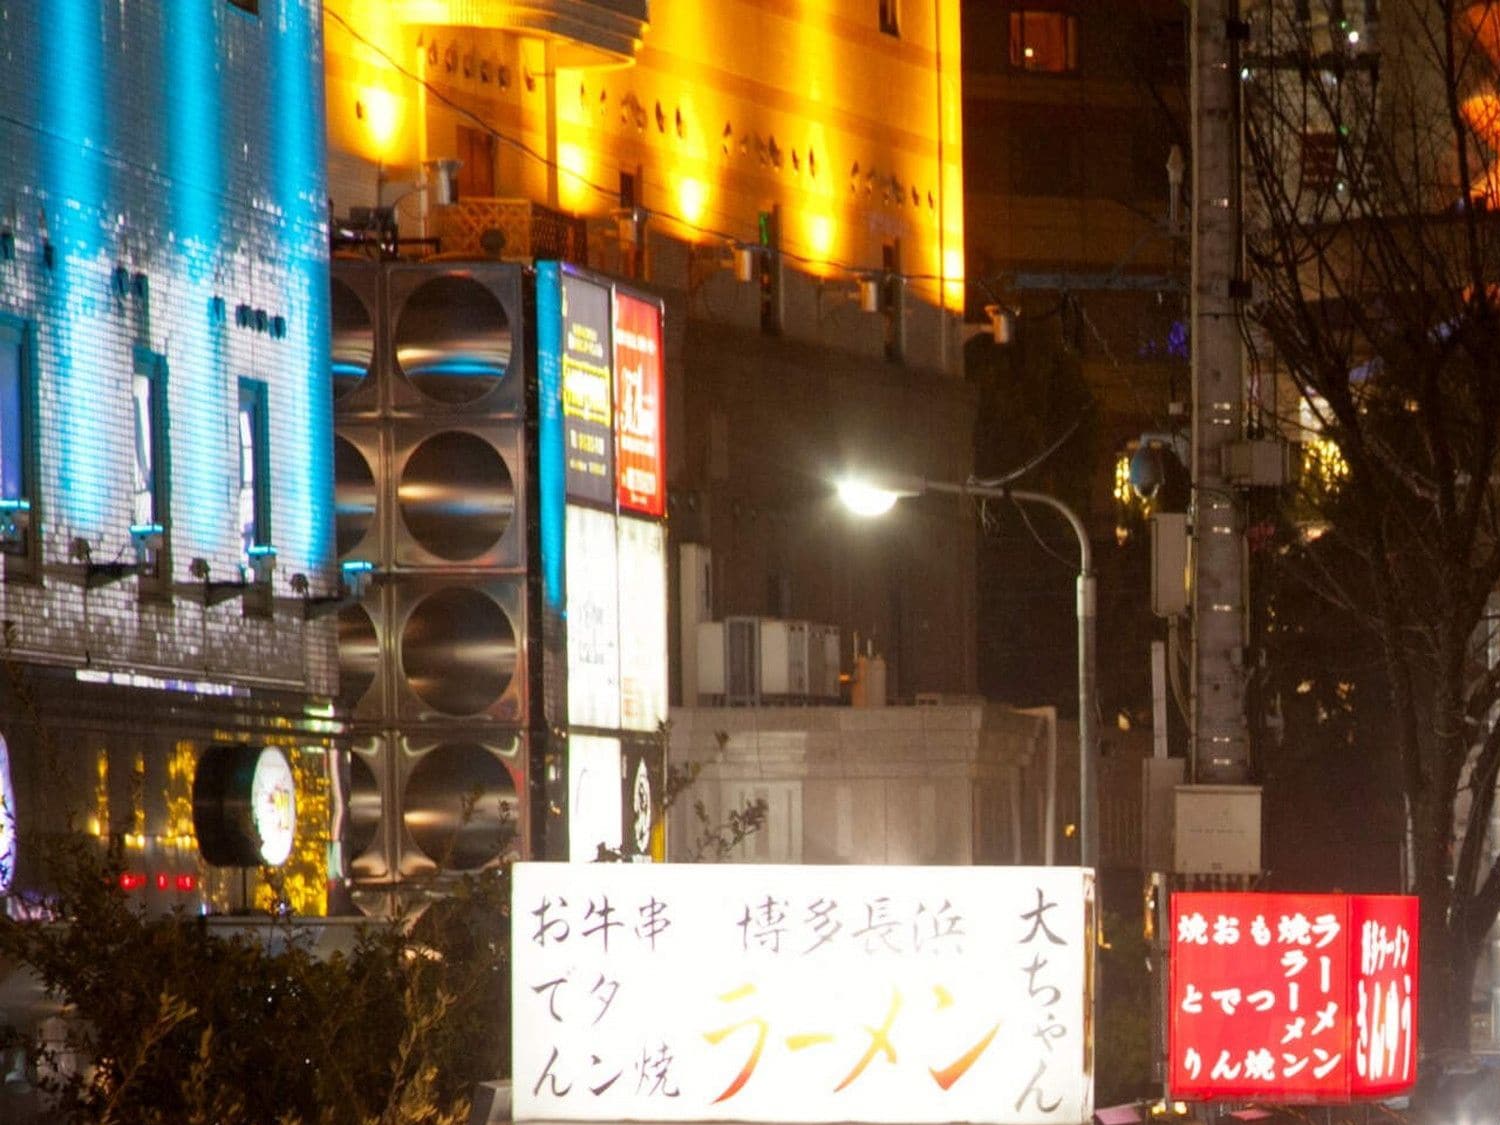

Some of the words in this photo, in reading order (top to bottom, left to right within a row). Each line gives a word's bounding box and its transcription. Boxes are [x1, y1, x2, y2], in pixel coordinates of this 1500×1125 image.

[737, 896, 967, 956] 博多長浜
[1015, 887, 1068, 1115] 大ちゃん
[1178, 912, 1209, 1081] 焼とり
[1210, 914, 1242, 1080] おでん
[1244, 914, 1276, 1081] もつ焼
[1278, 912, 1312, 1079] 焼ラーメン
[1311, 914, 1341, 1079] ラーメン
[702, 983, 1001, 1106] ラーメン
